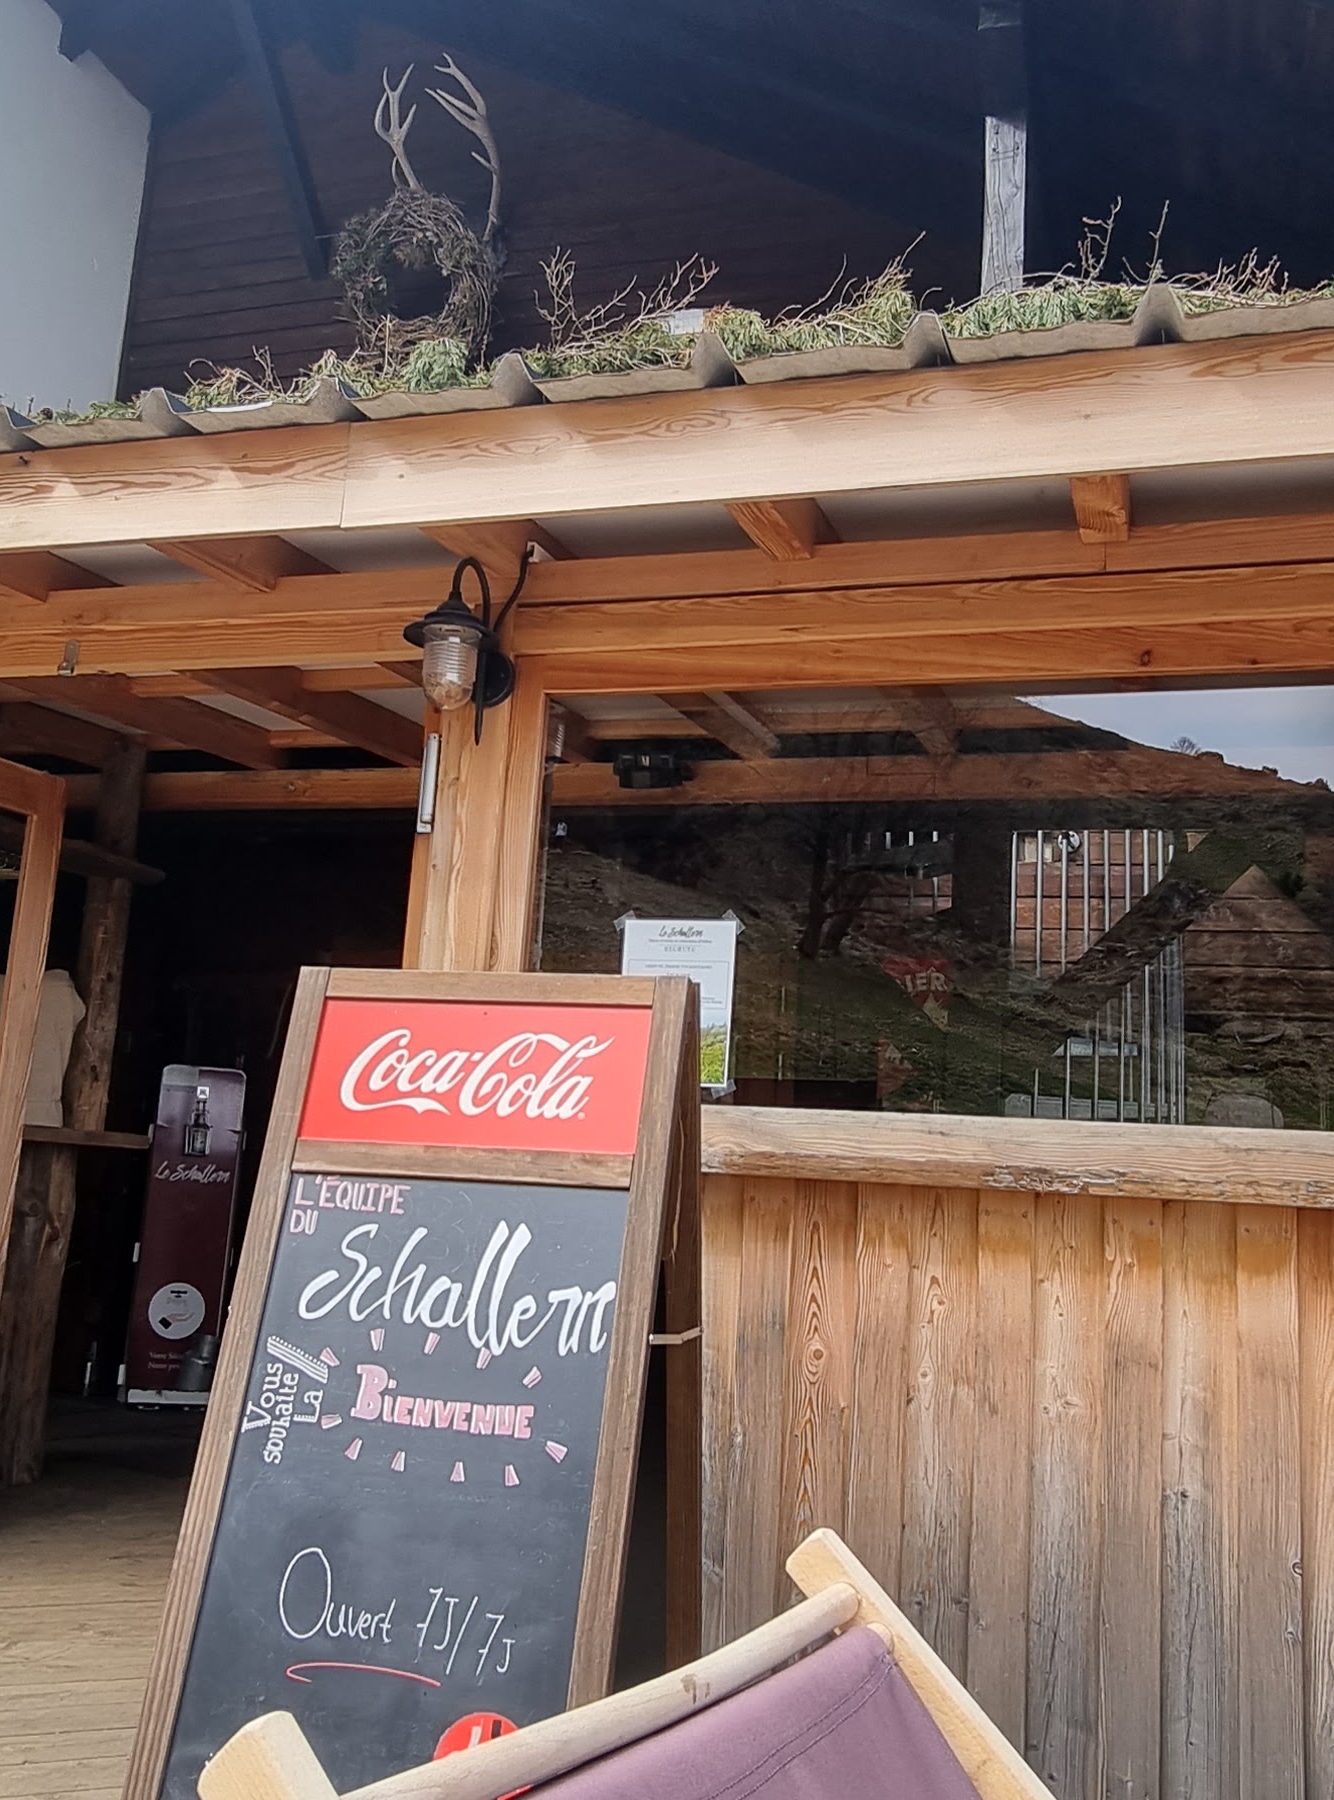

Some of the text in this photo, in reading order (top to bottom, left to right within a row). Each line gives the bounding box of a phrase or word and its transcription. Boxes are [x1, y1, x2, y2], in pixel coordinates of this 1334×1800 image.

[340, 1028, 616, 1119] Coca-Cola
[290, 1209, 319, 1235] DU
[294, 1175, 411, 1214] L'ÉQUIPE
[298, 1219, 617, 1356] Schallern
[240, 1362, 283, 1433] Vous
[262, 1372, 299, 1464] souhaite
[292, 1389, 324, 1423] La
[279, 1547, 397, 1644] Ouvert
